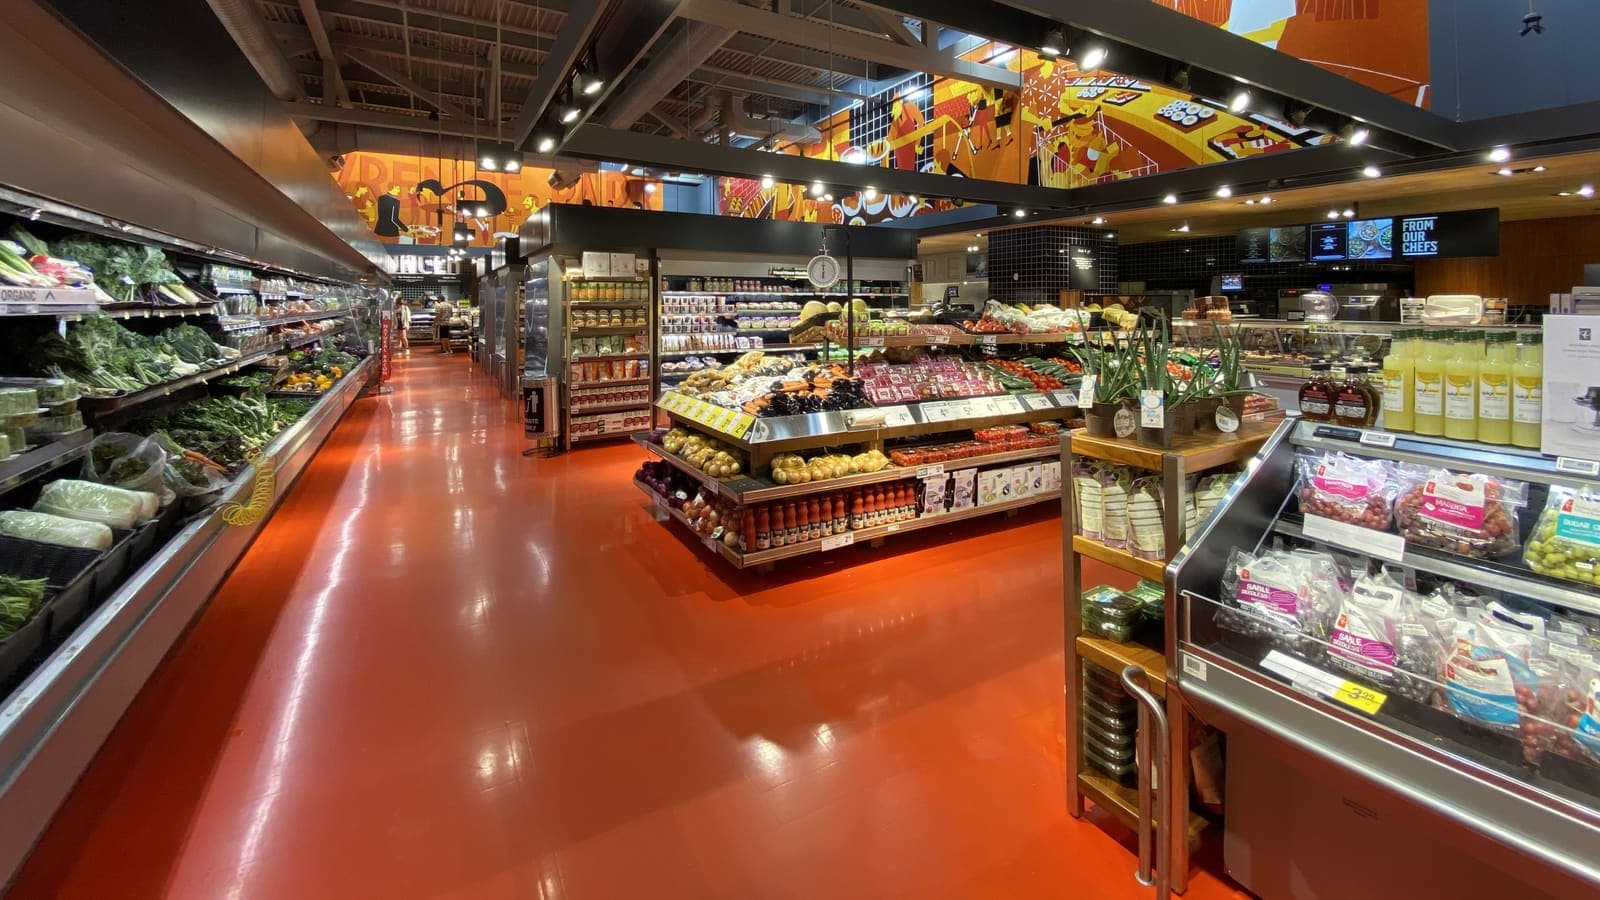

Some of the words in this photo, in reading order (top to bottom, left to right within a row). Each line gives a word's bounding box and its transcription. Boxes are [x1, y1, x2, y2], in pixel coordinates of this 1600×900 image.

[1402, 220, 1434, 231] FROM
[1402, 231, 1425, 242] OUR
[1402, 241, 1438, 253] CHEFS
[0, 289, 37, 301] ORGANIC
[1338, 633, 1362, 646] SABLE
